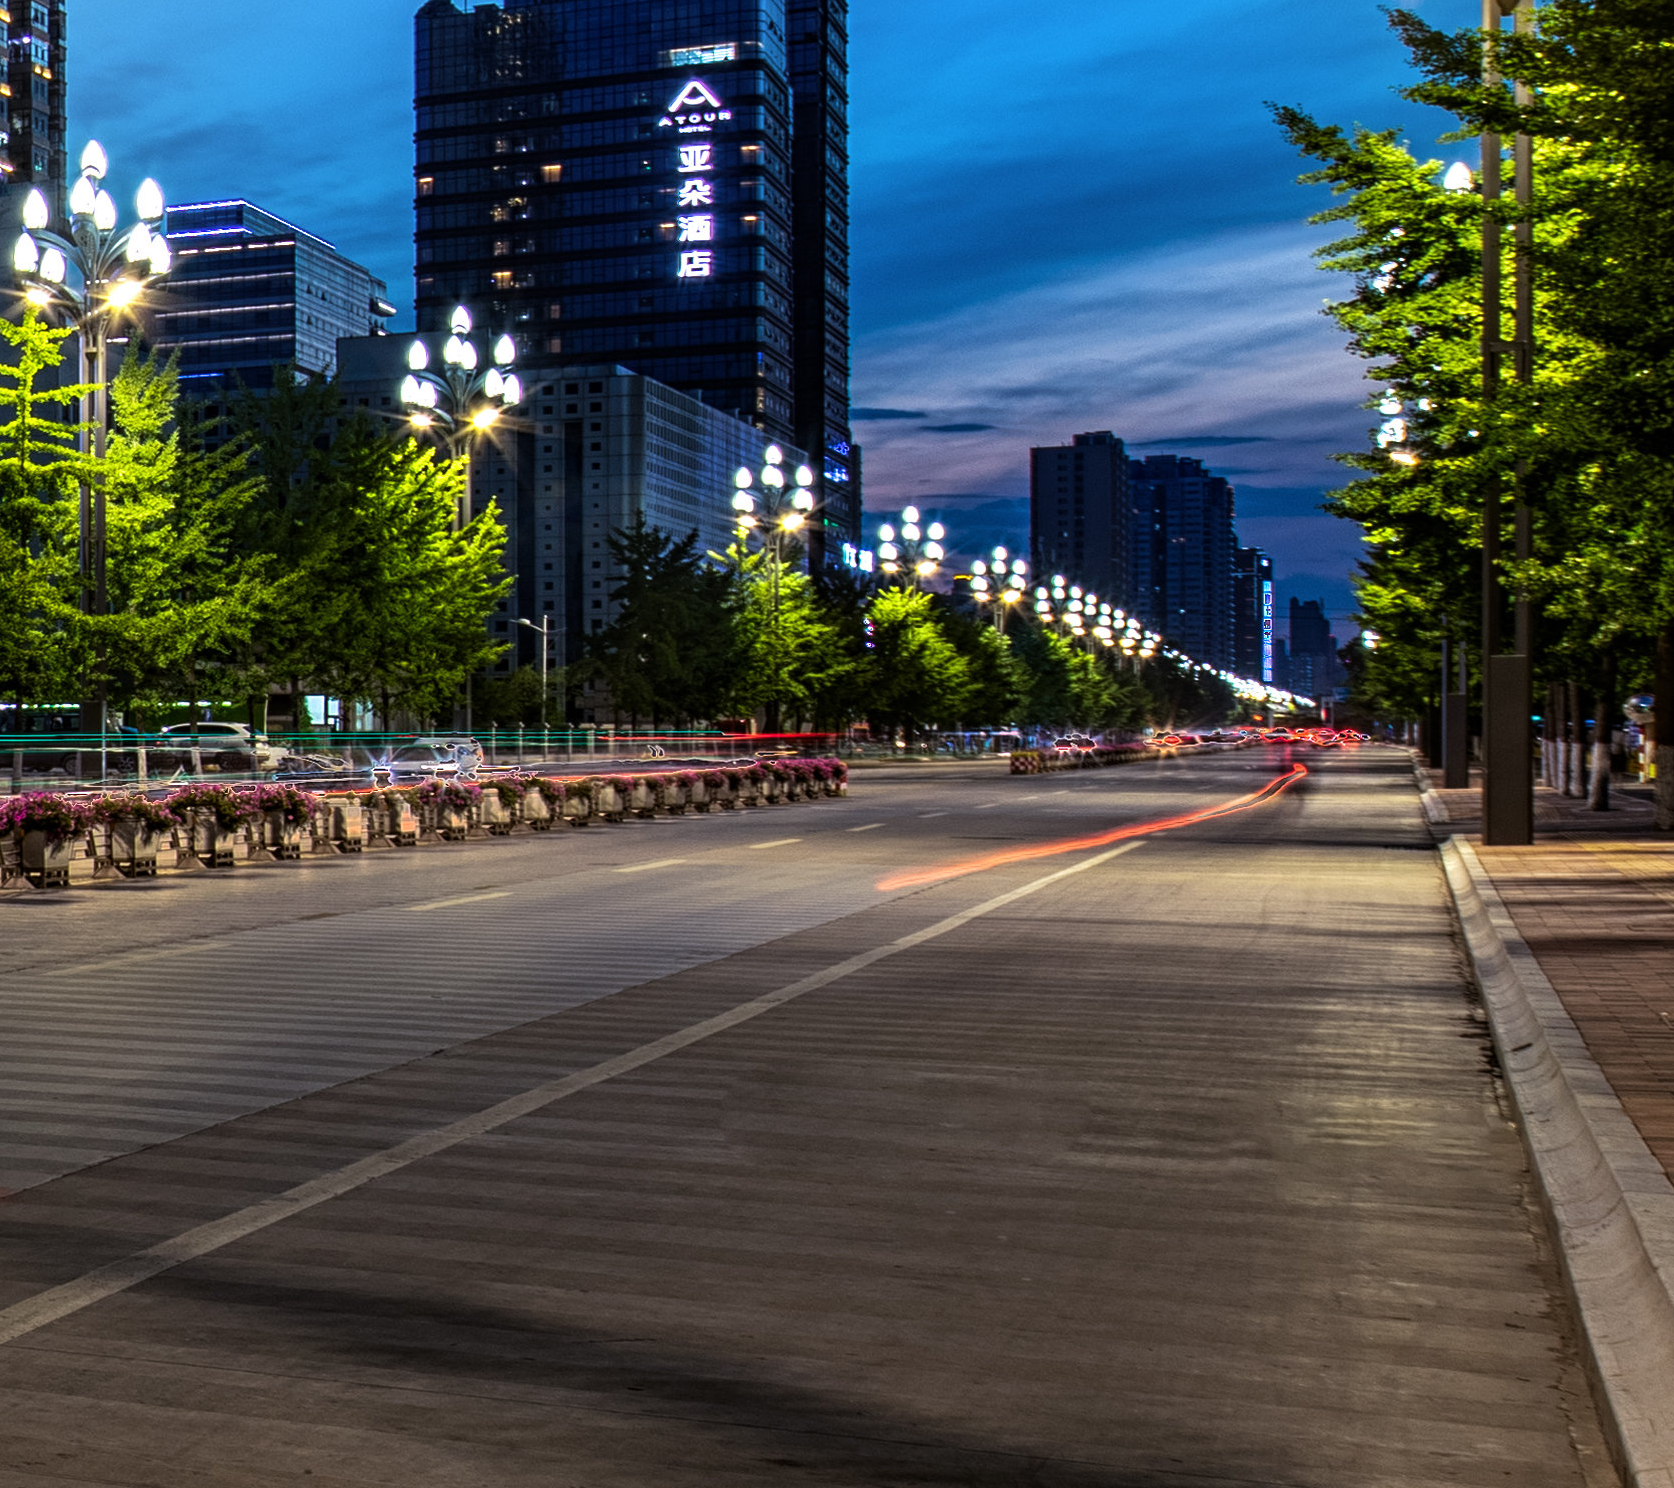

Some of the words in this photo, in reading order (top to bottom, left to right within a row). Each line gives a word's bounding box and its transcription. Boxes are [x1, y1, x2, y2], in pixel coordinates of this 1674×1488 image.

[658, 110, 732, 127] ATOUR
[677, 144, 713, 278] 亚朵酒店
